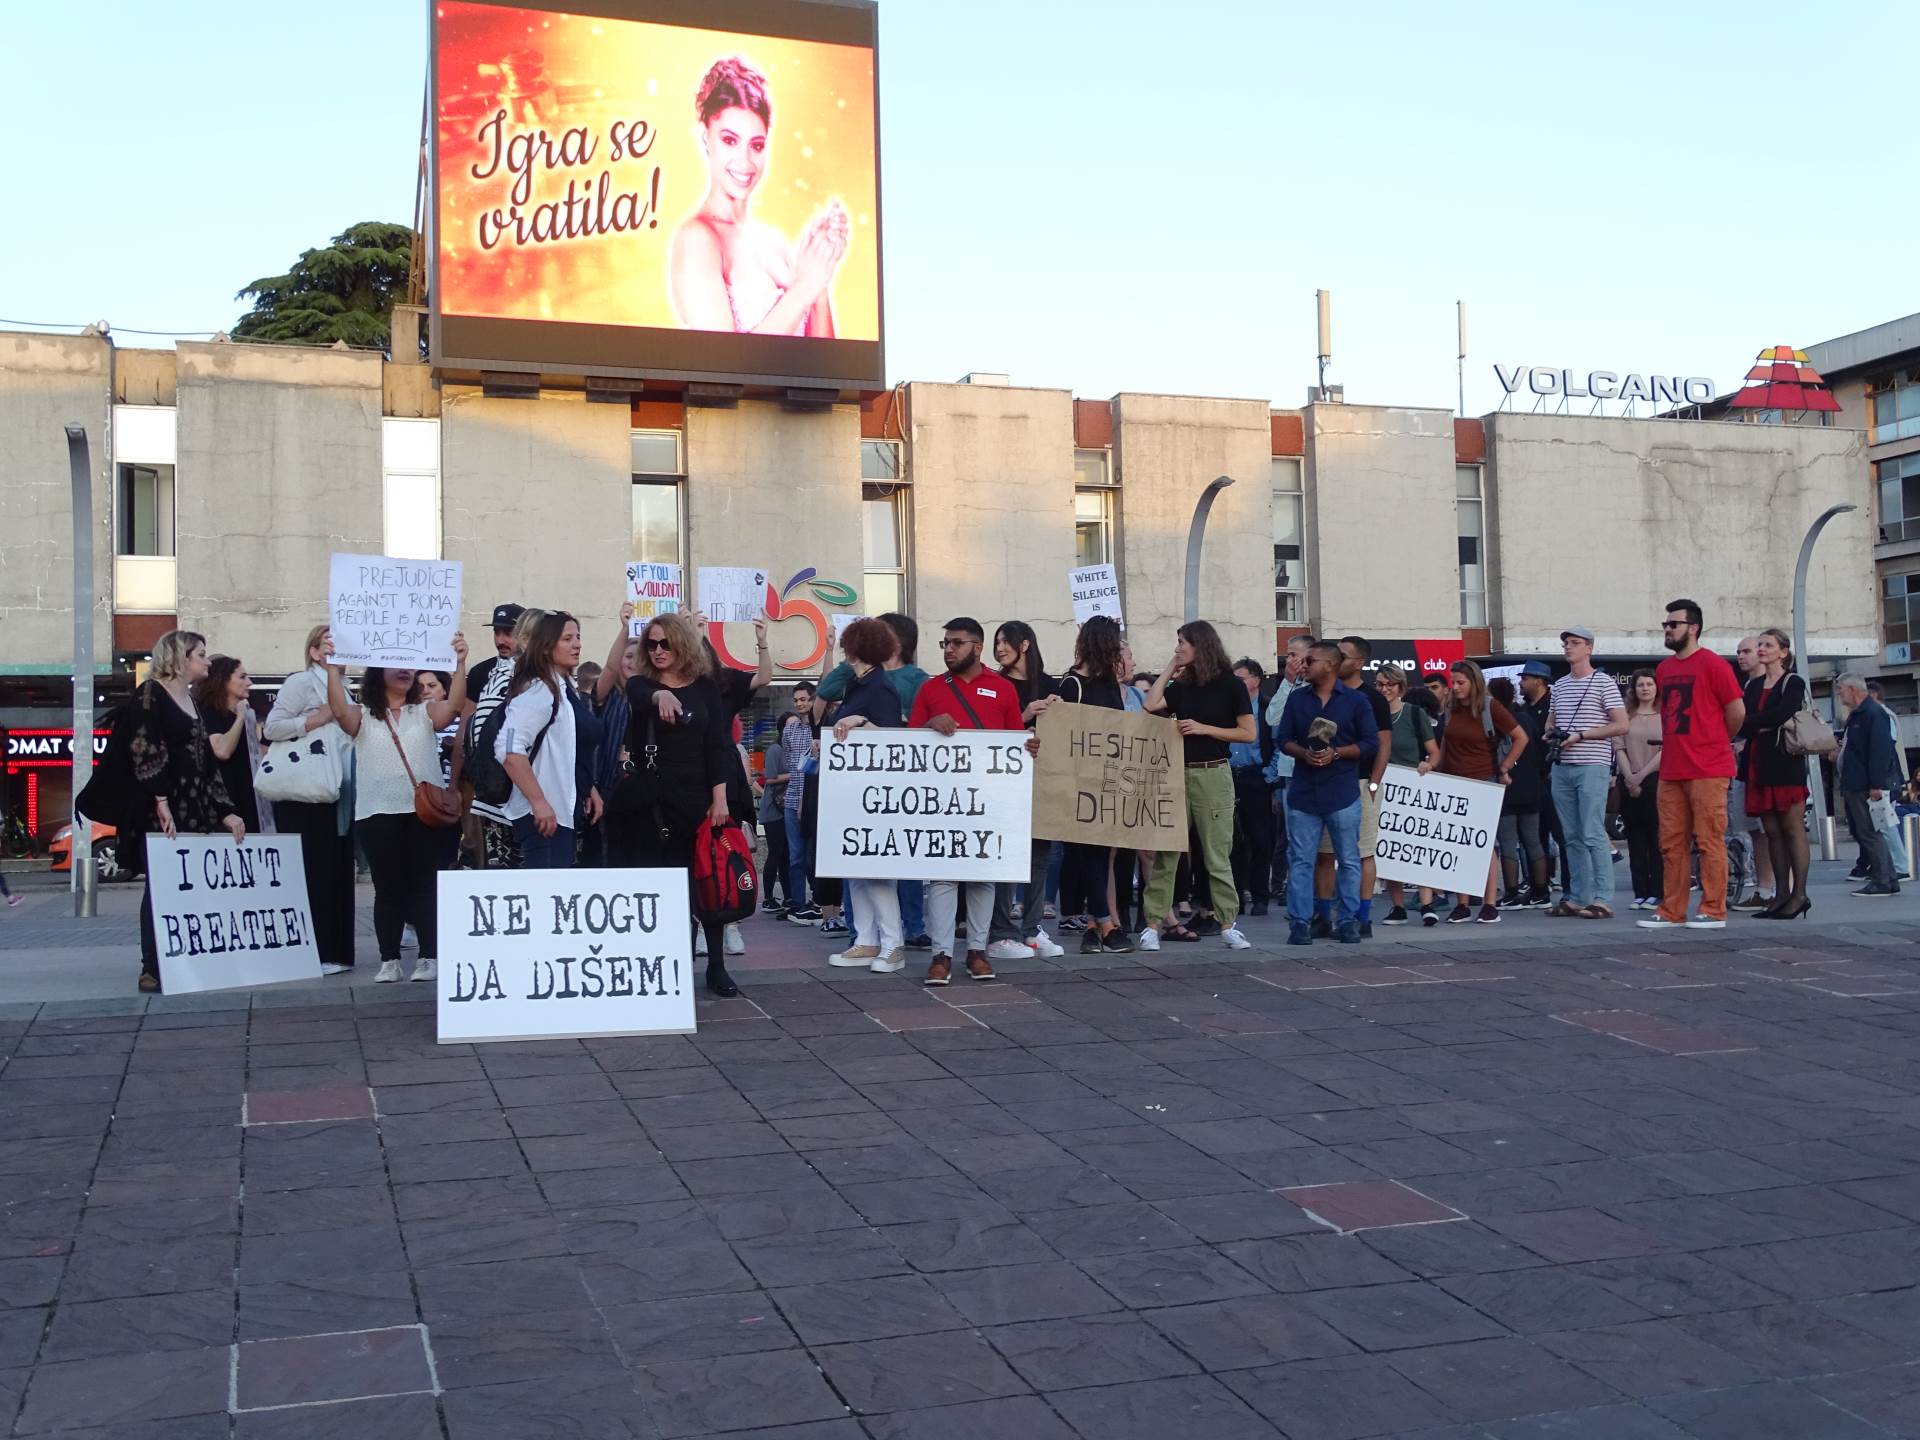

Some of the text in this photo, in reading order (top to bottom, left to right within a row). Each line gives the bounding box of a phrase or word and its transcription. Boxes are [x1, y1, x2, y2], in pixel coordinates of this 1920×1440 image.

[472, 109, 656, 206] Igra se
[479, 166, 660, 250] vratila!
[1493, 363, 1716, 404] VOLCANO
[636, 564, 669, 581] IF YOU
[1075, 571, 1109, 583] WHITE
[408, 592, 454, 611] ROMA
[632, 600, 656, 618] HURT
[1072, 586, 1118, 601] SILENCE
[1092, 603, 1101, 611] IS
[336, 609, 451, 627] PEOPLE IS ALSO
[1423, 658, 1447, 671] club
[828, 743, 1024, 775] SILENCE IS
[862, 785, 985, 816] GLOBAL
[1384, 782, 1469, 817] UTANJE
[842, 827, 1003, 860] SLAVERY!
[1378, 811, 1488, 849] GLOBALNO
[176, 847, 281, 891] I CAN'T
[1376, 839, 1458, 873] OPSTVO!
[468, 892, 660, 936] NE MOGU
[161, 907, 310, 958] BREATHE!
[448, 943, 681, 1002] DA DIŠEM!
